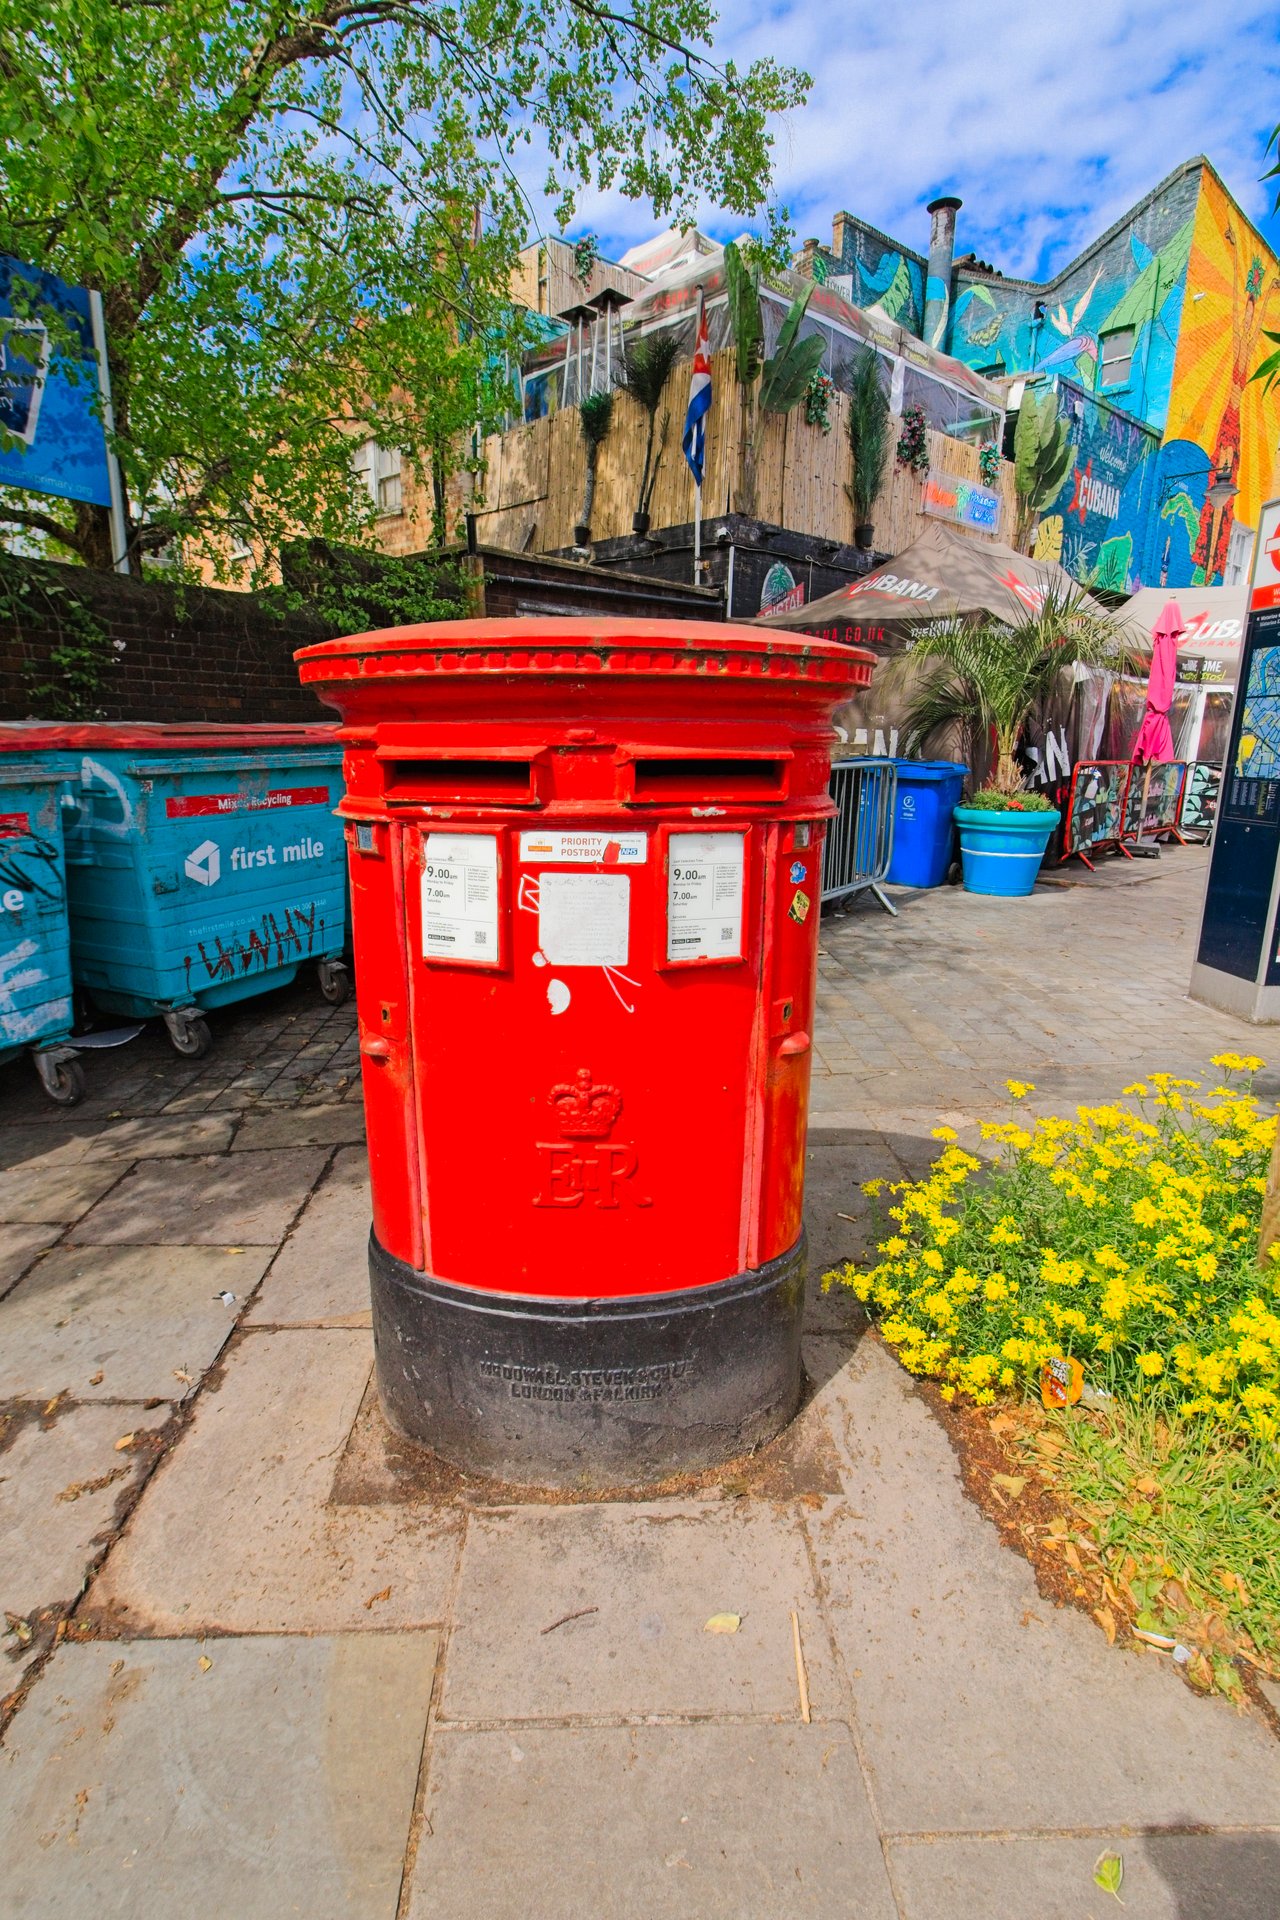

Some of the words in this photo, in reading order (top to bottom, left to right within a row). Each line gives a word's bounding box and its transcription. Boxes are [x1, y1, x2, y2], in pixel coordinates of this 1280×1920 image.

[1078, 475, 1121, 520] CUBANA
[850, 574, 940, 601] CUBANA
[251, 794, 292, 807] Recycling
[561, 838, 602, 846] PRIORITY
[230, 844, 277, 871] first
[282, 837, 324, 863] mile
[561, 848, 602, 857] POSTBOX
[621, 848, 638, 856] NHS
[673, 868, 707, 881] 9.00am
[673, 891, 698, 900] 7.00am
[511, 1382, 575, 1402] LONDON
[593, 1383, 661, 1401] FALKIRK
